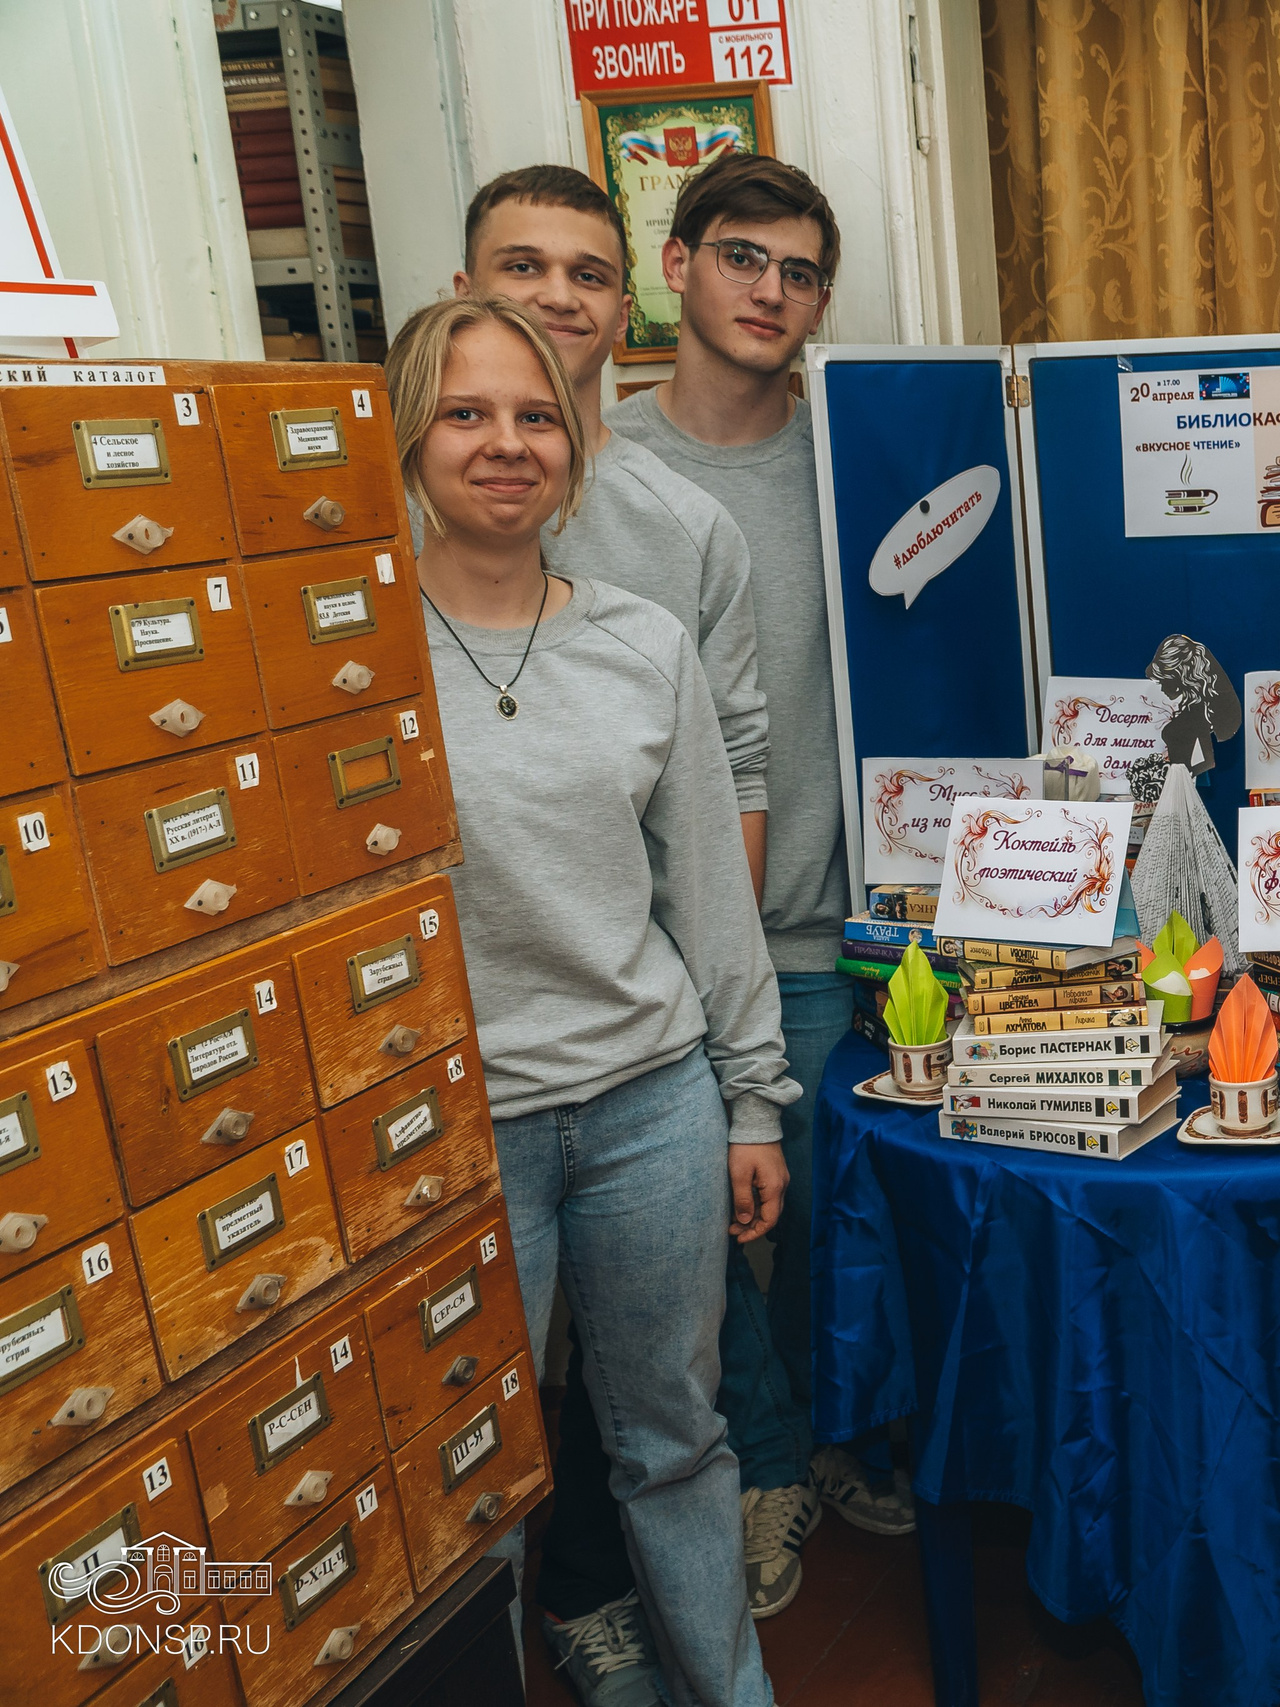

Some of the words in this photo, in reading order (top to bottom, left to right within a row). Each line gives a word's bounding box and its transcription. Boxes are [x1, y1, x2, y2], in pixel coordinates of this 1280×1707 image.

[570, 0, 610, 31] ПРИ
[614, 0, 699, 29] ПОЖАРЕ
[727, 0, 760, 22] 01
[725, 32, 773, 43] МОБИЛЬНОГО
[592, 40, 686, 80] ЗВОНИТЬ
[725, 45, 775, 78] 112
[0, 366, 47, 382] кий
[74, 368, 157, 383] каталог
[1164, 379, 1180, 387] 17.00
[357, 393, 365, 411] 4
[1130, 382, 1151, 403] 20
[1152, 391, 1194, 404] апреля
[182, 397, 192, 418] 3
[100, 436, 139, 447] Сельское
[1135, 441, 1191, 453] «ВКУСНОЕ
[1193, 440, 1240, 451] ЧТЕНИЕ»
[106, 459, 139, 468] хозяйство
[113, 450, 135, 458] лесное
[893, 490, 983, 570] #люблючитать
[214, 583, 222, 603] 7
[143, 618, 172, 627] Культура.
[140, 629, 159, 637] Наука.
[402, 717, 417, 735] 12
[1096, 707, 1150, 728] Десерт
[1084, 733, 1107, 747] для
[1111, 737, 1156, 748] милых
[239, 761, 257, 782] 11
[1104, 755, 1132, 769] дам
[23, 819, 45, 844] 10
[166, 820, 191, 835] Русская
[192, 811, 219, 827] литерат.
[911, 817, 928, 835] из
[993, 830, 1076, 853] Коктейль
[979, 867, 1077, 884] поэтический
[421, 916, 438, 935] 15
[866, 924, 899, 938] ТРАУБ
[1010, 948, 1039, 960] ТУШНОВА
[369, 961, 403, 976] Зарубежных
[377, 974, 393, 984] стран
[1011, 975, 1042, 986] ДОЛИНА
[256, 986, 273, 1009] 14
[1008, 994, 1029, 1002] Марина
[1063, 990, 1093, 998] Избранная
[1069, 996, 1088, 1004] лирика
[1000, 999, 1039, 1011] ЦВЕТАЕВА
[1005, 1022, 1047, 1032] АХМАТОВА
[1075, 1016, 1095, 1024] Лирика
[189, 1043, 226, 1063] Литература
[999, 1044, 1036, 1056] Борис
[1040, 1040, 1112, 1054] ПАСТЕРНАК
[192, 1058, 218, 1073] народов
[218, 1050, 239, 1063] России
[449, 1058, 462, 1079] 18
[50, 1070, 73, 1096] 13
[989, 1073, 1030, 1085] Сергей
[1035, 1071, 1104, 1084] МИХАЛКОВ
[987, 1098, 1037, 1111] Николай
[1040, 1100, 1093, 1113] ГУМИЛЕВ
[979, 1125, 1025, 1140] Валерий
[1029, 1130, 1076, 1146] БРЮСОВ
[287, 1146, 304, 1170] 17
[222, 1203, 264, 1232] предметный
[227, 1219, 262, 1242] указатель
[482, 1236, 496, 1259] 15
[85, 1249, 109, 1279] 16
[434, 1292, 466, 1324] СЕР-СЯ
[0, 1325, 45, 1354] рубежных
[5, 1345, 30, 1363] стран
[332, 1341, 348, 1366] 14
[504, 1372, 518, 1395] 18
[268, 1399, 312, 1436] Р-С-СЕН
[453, 1427, 483, 1466] Ш-Я
[146, 1464, 168, 1494] 13
[358, 1487, 374, 1515] 17
[294, 1548, 346, 1594] Ф-Х-Ц-Ч
